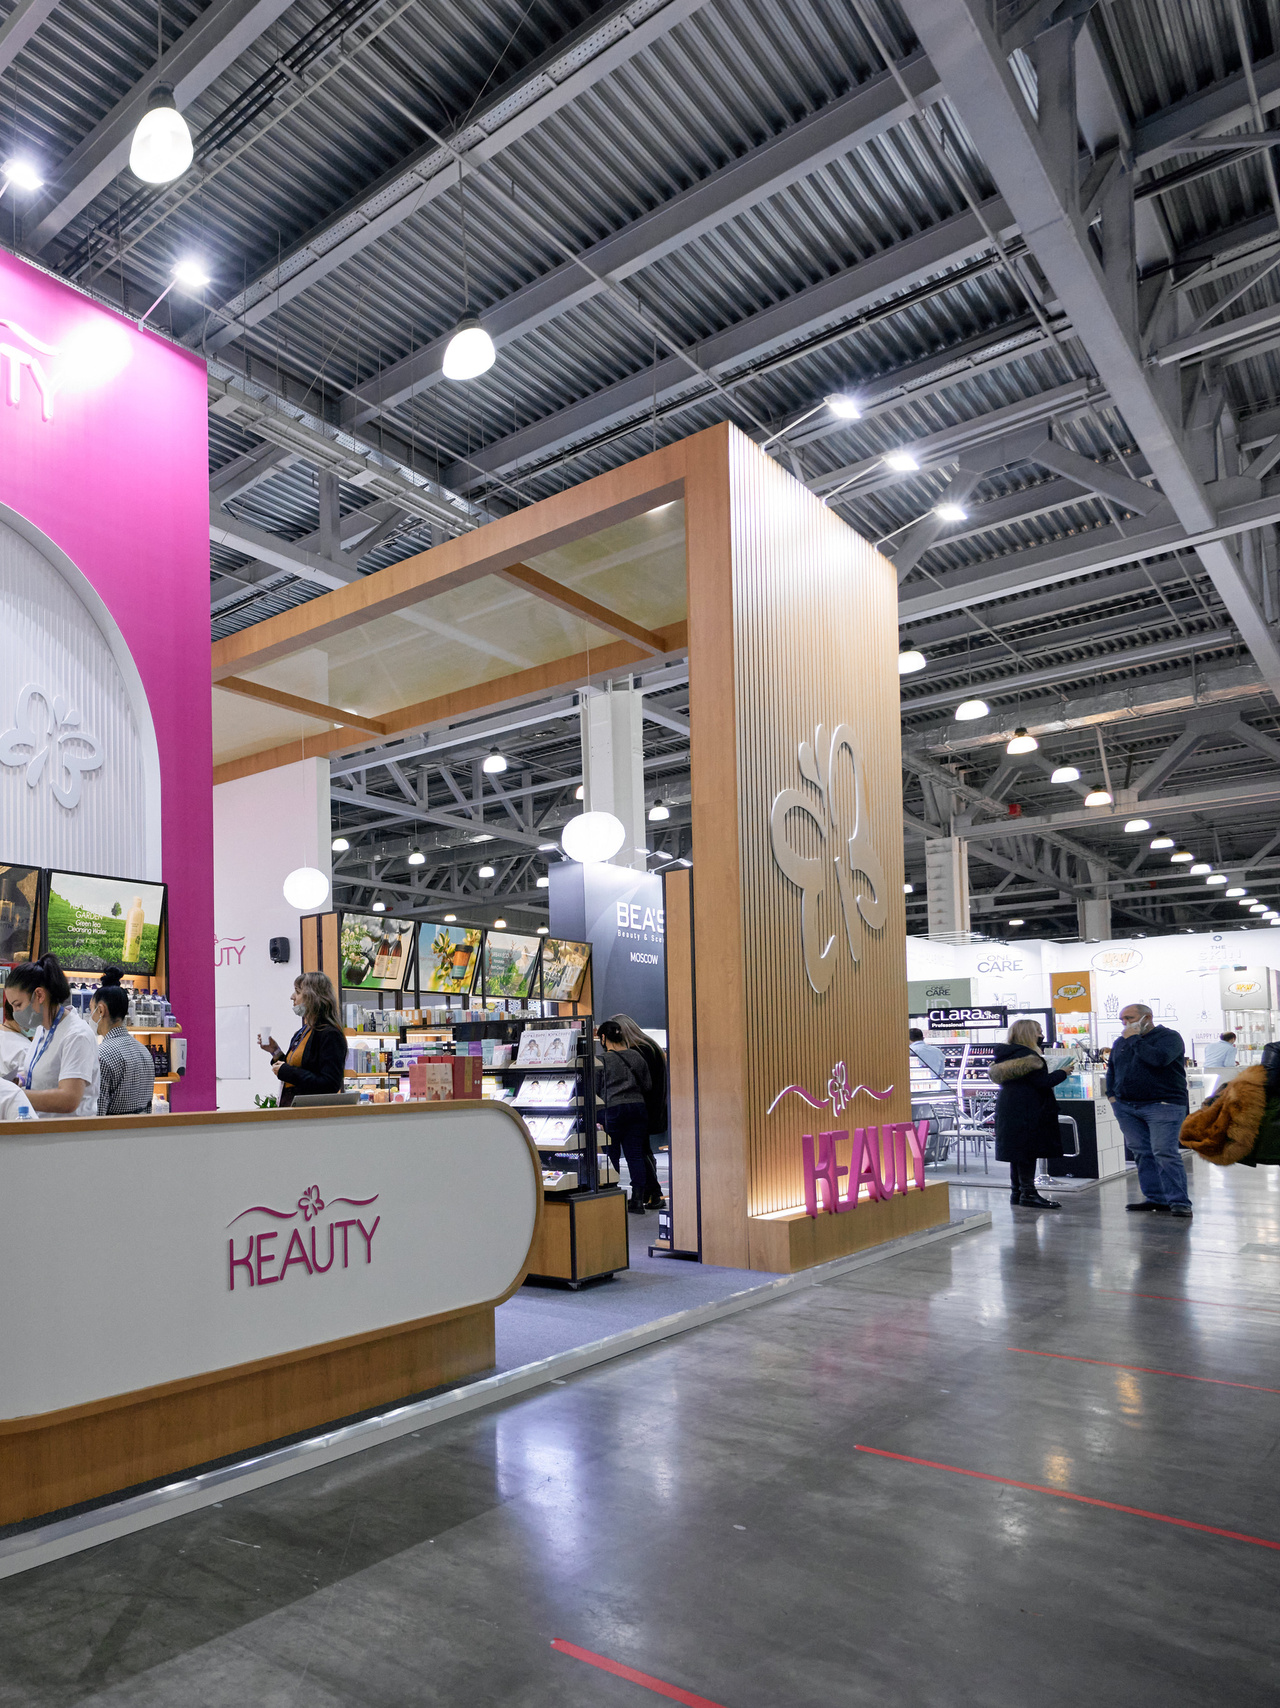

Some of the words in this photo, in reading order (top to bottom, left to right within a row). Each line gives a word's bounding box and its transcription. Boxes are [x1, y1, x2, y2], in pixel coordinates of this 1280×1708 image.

[75, 910, 103, 921] GARDEN
[75, 919, 92, 928] Green
[617, 929, 640, 941] Beauty
[630, 951, 659, 965] MOSCOW
[977, 960, 1024, 973] CARE
[925, 988, 951, 997] CARE
[802, 1120, 931, 1219] KEAUTY
[228, 1215, 381, 1291] KEAUTY
